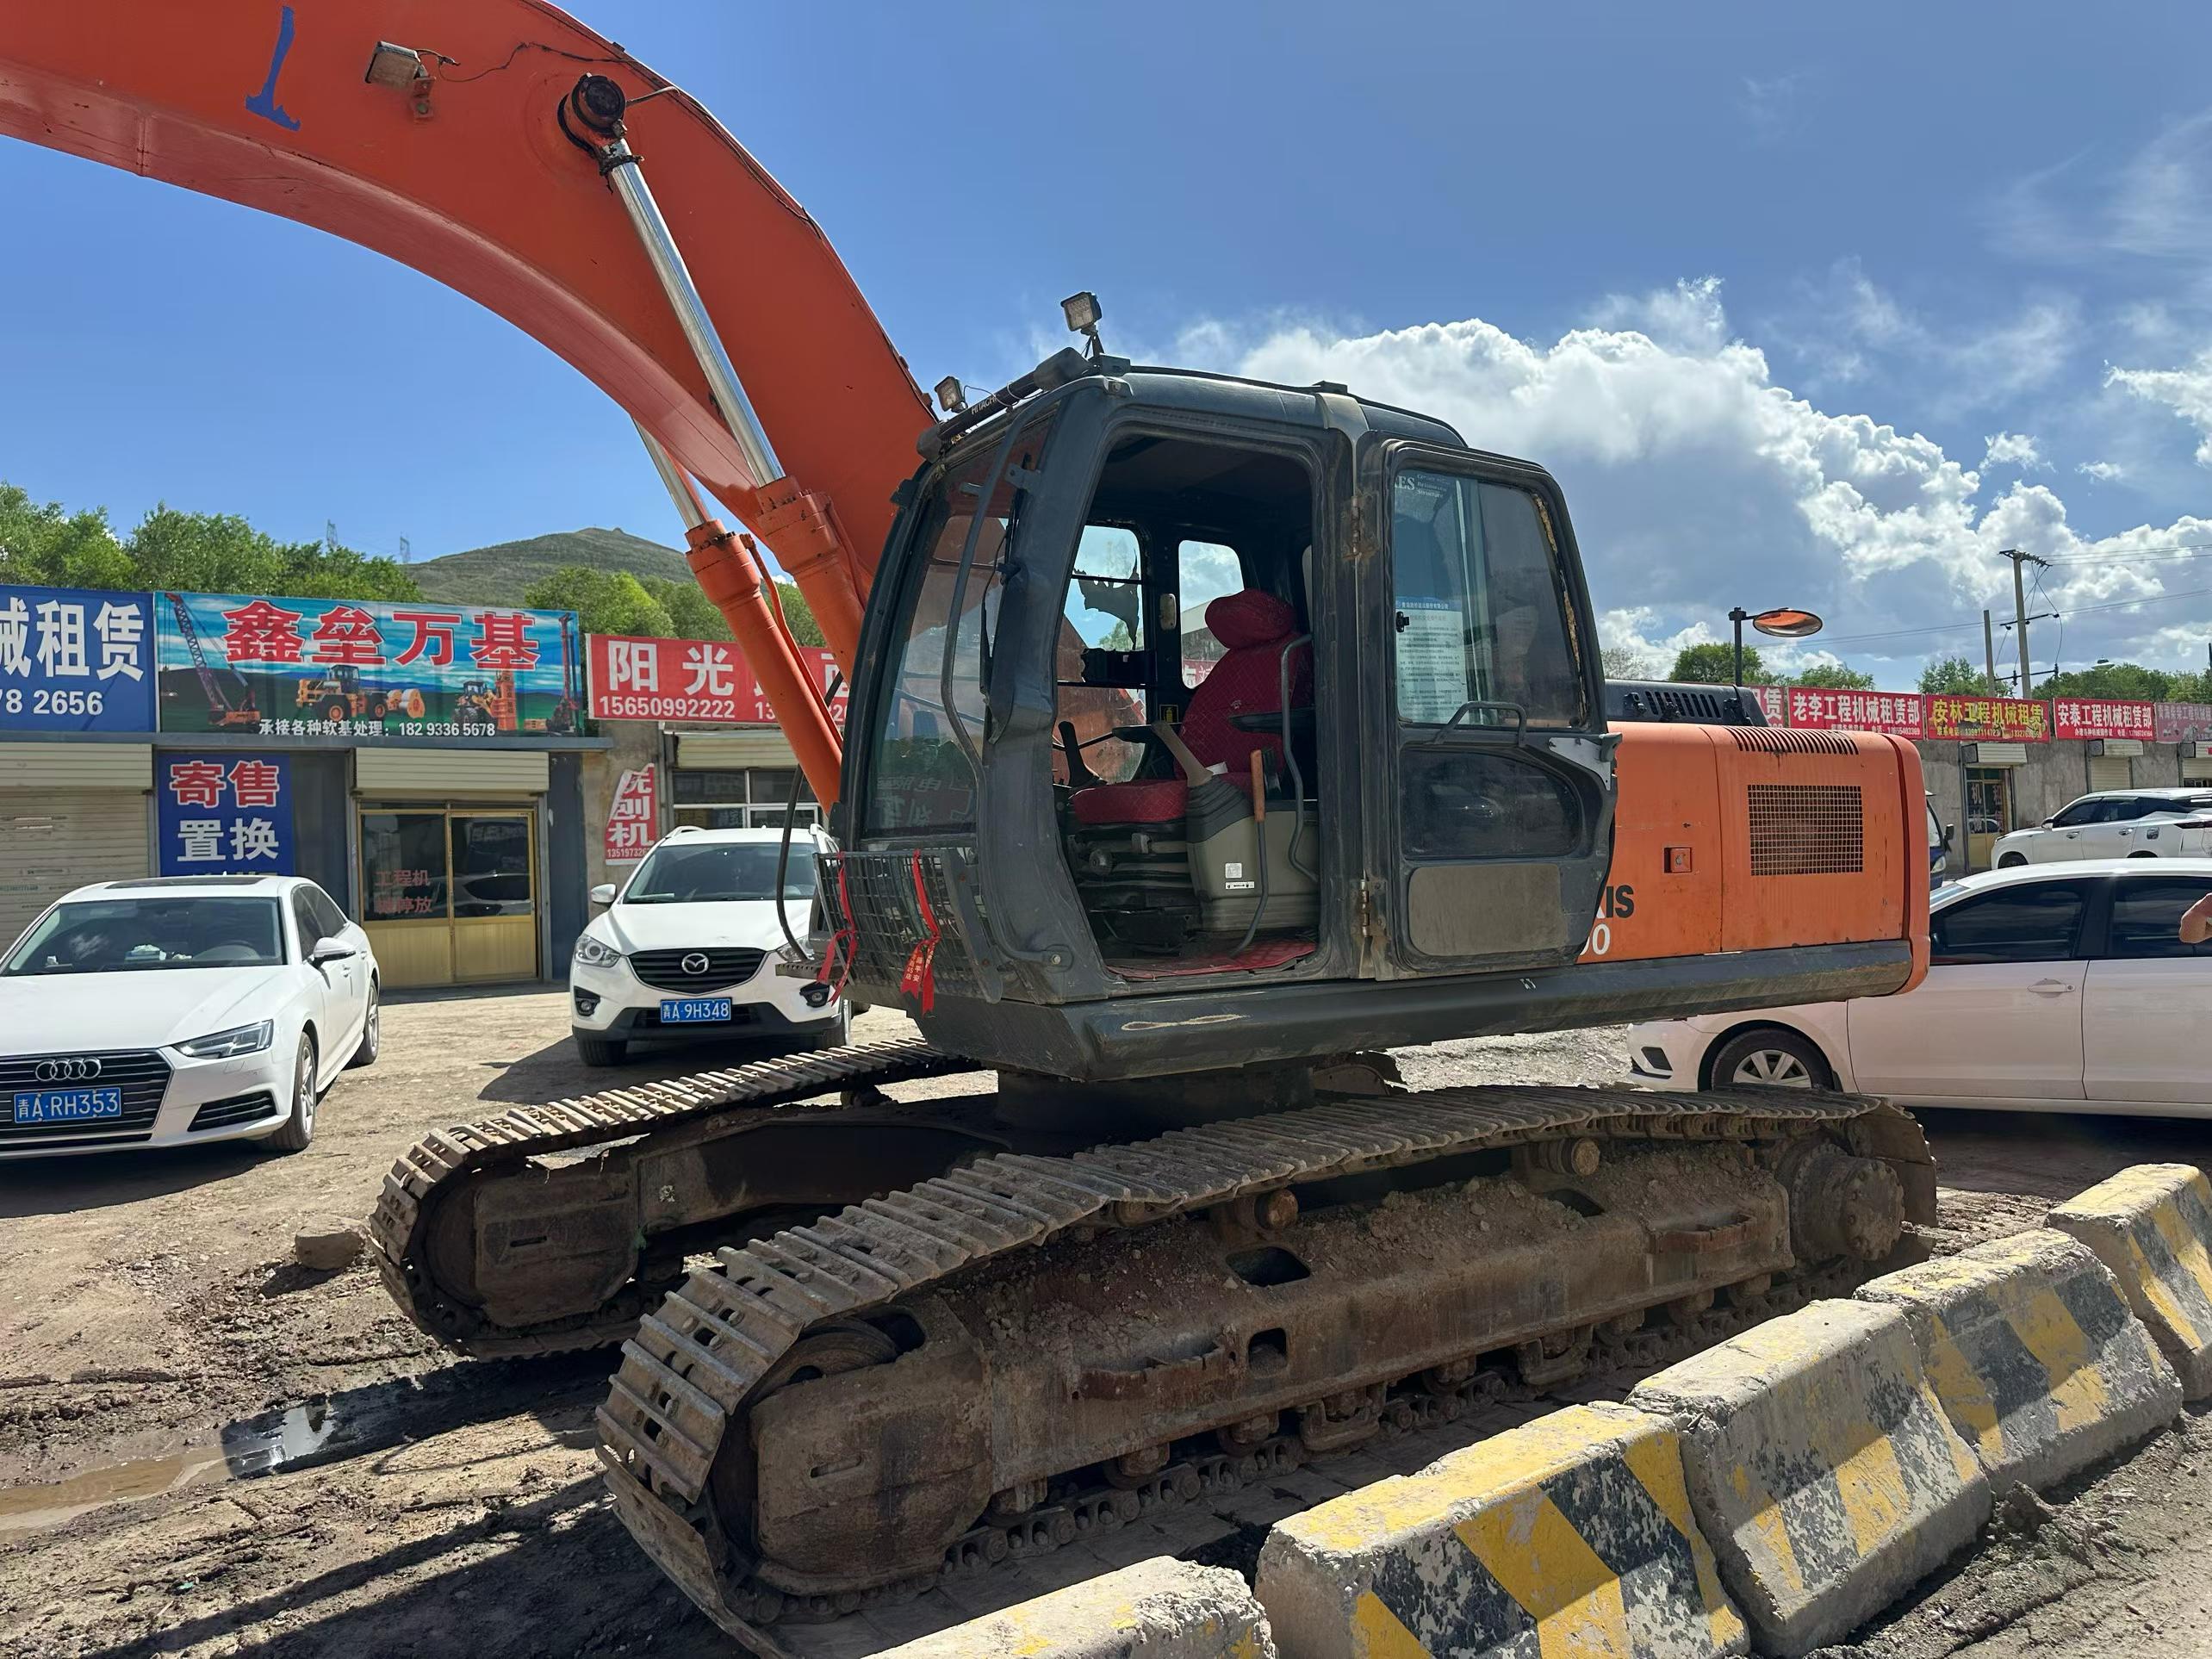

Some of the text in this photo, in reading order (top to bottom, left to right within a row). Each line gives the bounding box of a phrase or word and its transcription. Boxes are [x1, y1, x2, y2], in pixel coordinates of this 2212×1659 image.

[1395, 475, 1415, 490] ES
[221, 600, 541, 671] 鑫垒万基
[0, 689, 103, 715] 8 2656
[600, 695, 736, 719] 15650992222
[1793, 692, 1920, 726] 老李工程机械租赁部
[399, 722, 423, 736] 182
[426, 723, 459, 736] 9336
[463, 723, 496, 736] 5678
[2057, 702, 2153, 730] 安泰工程机械租赁部
[170, 761, 280, 808] 寄售
[177, 817, 280, 862] 置换
[375, 868, 431, 887] 工程机
